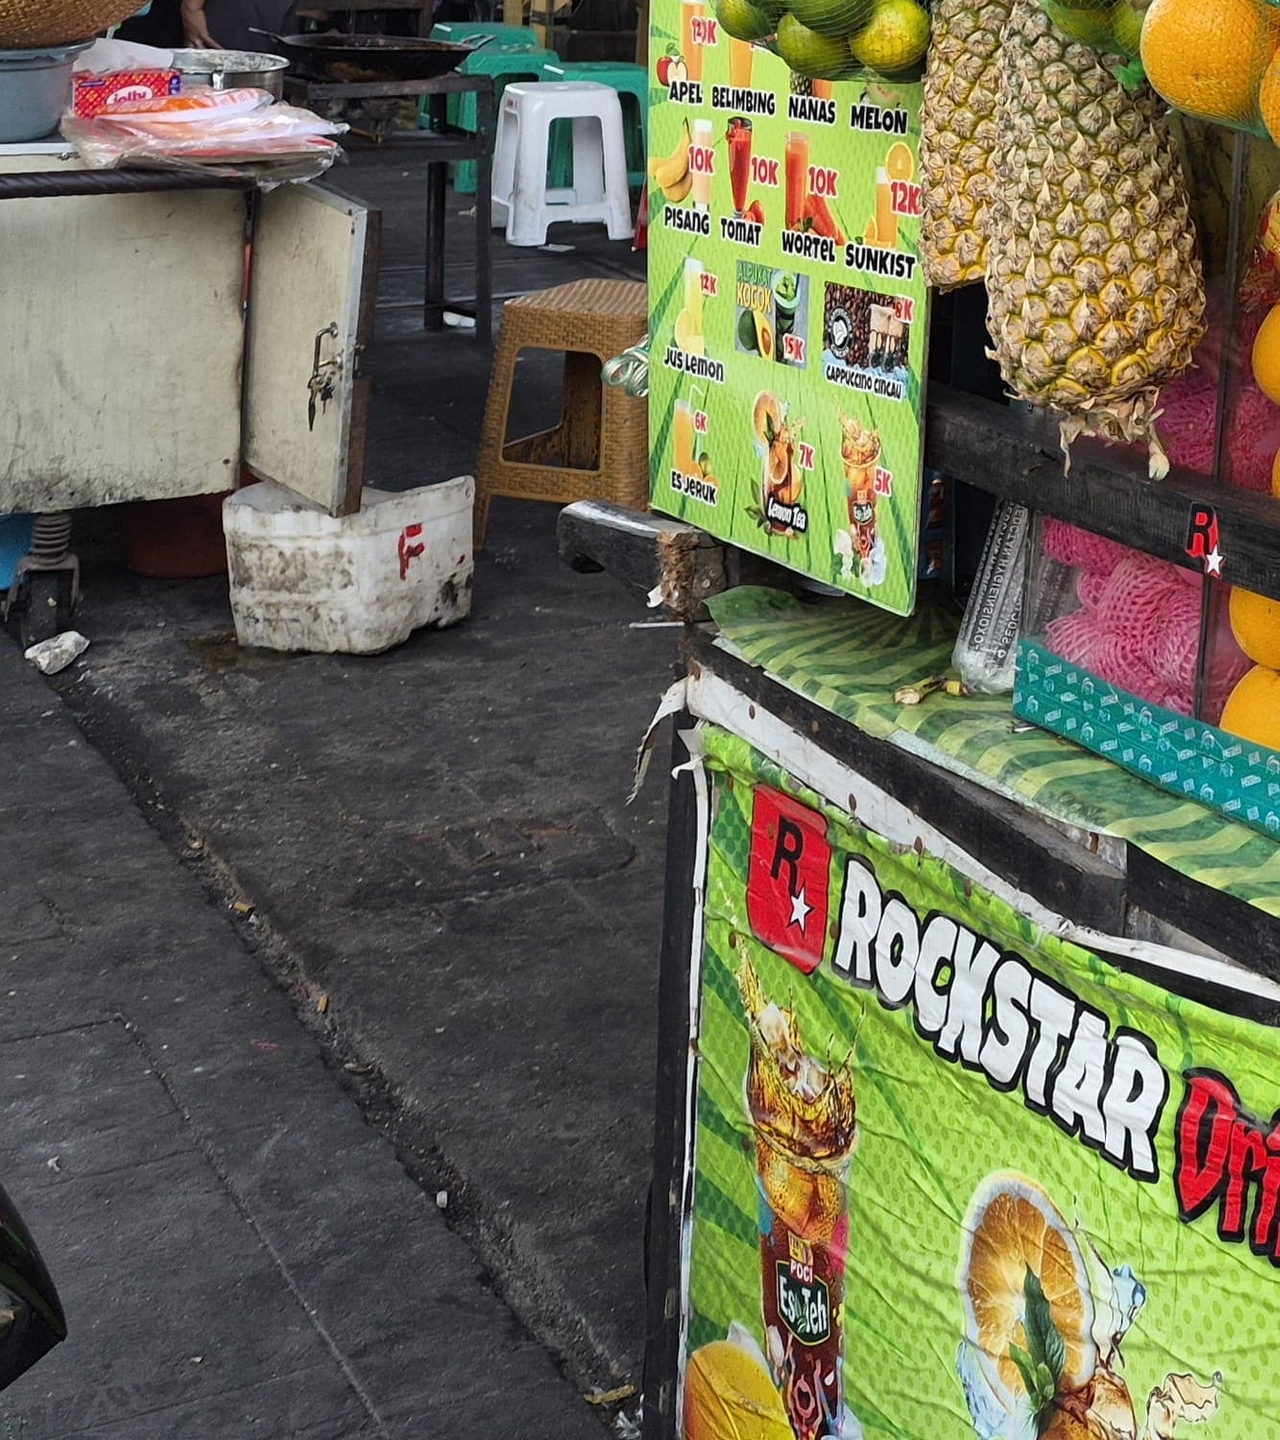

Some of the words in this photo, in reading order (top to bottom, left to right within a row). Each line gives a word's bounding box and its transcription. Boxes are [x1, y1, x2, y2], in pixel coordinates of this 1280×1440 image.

[670, 81, 702, 105] APEL
[712, 86, 775, 115] BELIMBING
[789, 95, 836, 124] NANAS
[851, 105, 907, 134] MELON
[688, 146, 714, 174] 10K
[752, 157, 778, 185] 10K
[808, 166, 838, 197] 10K
[891, 181, 922, 216] 12K
[664, 206, 710, 235] PISANG
[721, 218, 762, 247] TOMAT
[845, 244, 917, 279] SUNKIST
[664, 346, 684, 370] JUS
[694, 412, 708, 434] 6K
[799, 444, 814, 470] 7K
[671, 470, 684, 490] ES
[874, 468, 892, 497] 5K
[832, 853, 1169, 1184] ROCKSTAR
[790, 1259, 813, 1284] POCI
[779, 1275, 795, 1324] Es
[801, 1287, 828, 1335] Teh
